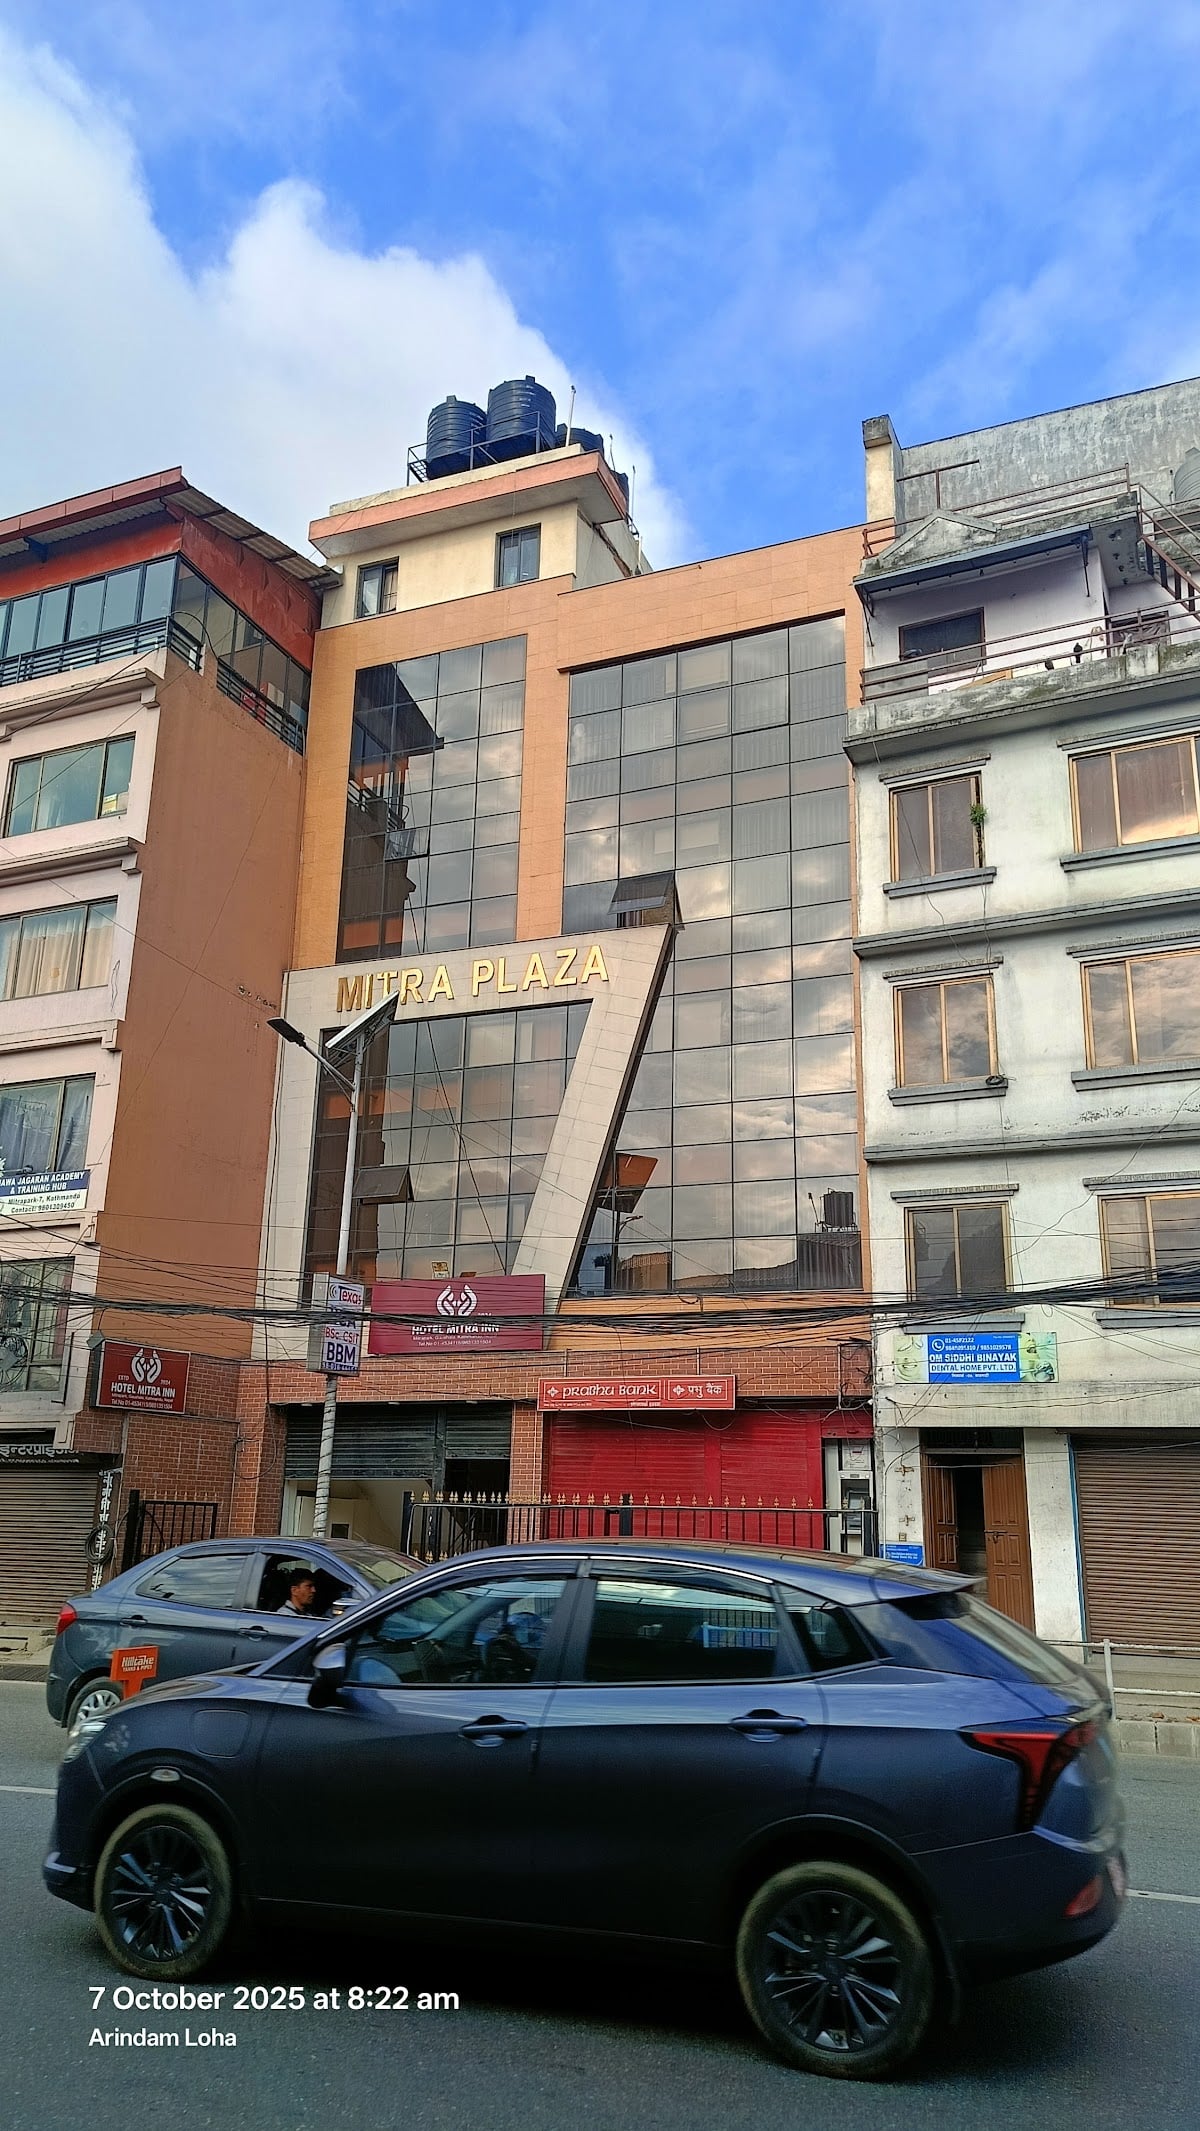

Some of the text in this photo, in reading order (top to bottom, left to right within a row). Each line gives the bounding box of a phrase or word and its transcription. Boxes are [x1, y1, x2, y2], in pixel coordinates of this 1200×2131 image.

[336, 944, 609, 1013] MITRA PLAZA
[17, 1174, 50, 1185] JAGARAN
[51, 1171, 85, 1182] ACADEMY
[17, 1184, 51, 1194] TRAINING
[52, 1182, 67, 1191] HUB
[338, 1285, 362, 1305] Texas
[326, 1341, 356, 1366] BBM
[929, 1352, 1017, 1363] OM SIDDHI BINAYAK
[931, 1364, 959, 1372] DENTAL
[960, 1363, 982, 1372] HOME
[1000, 1363, 1016, 1372] LTD.
[111, 1381, 176, 1398] HOTEL MITRA INN
